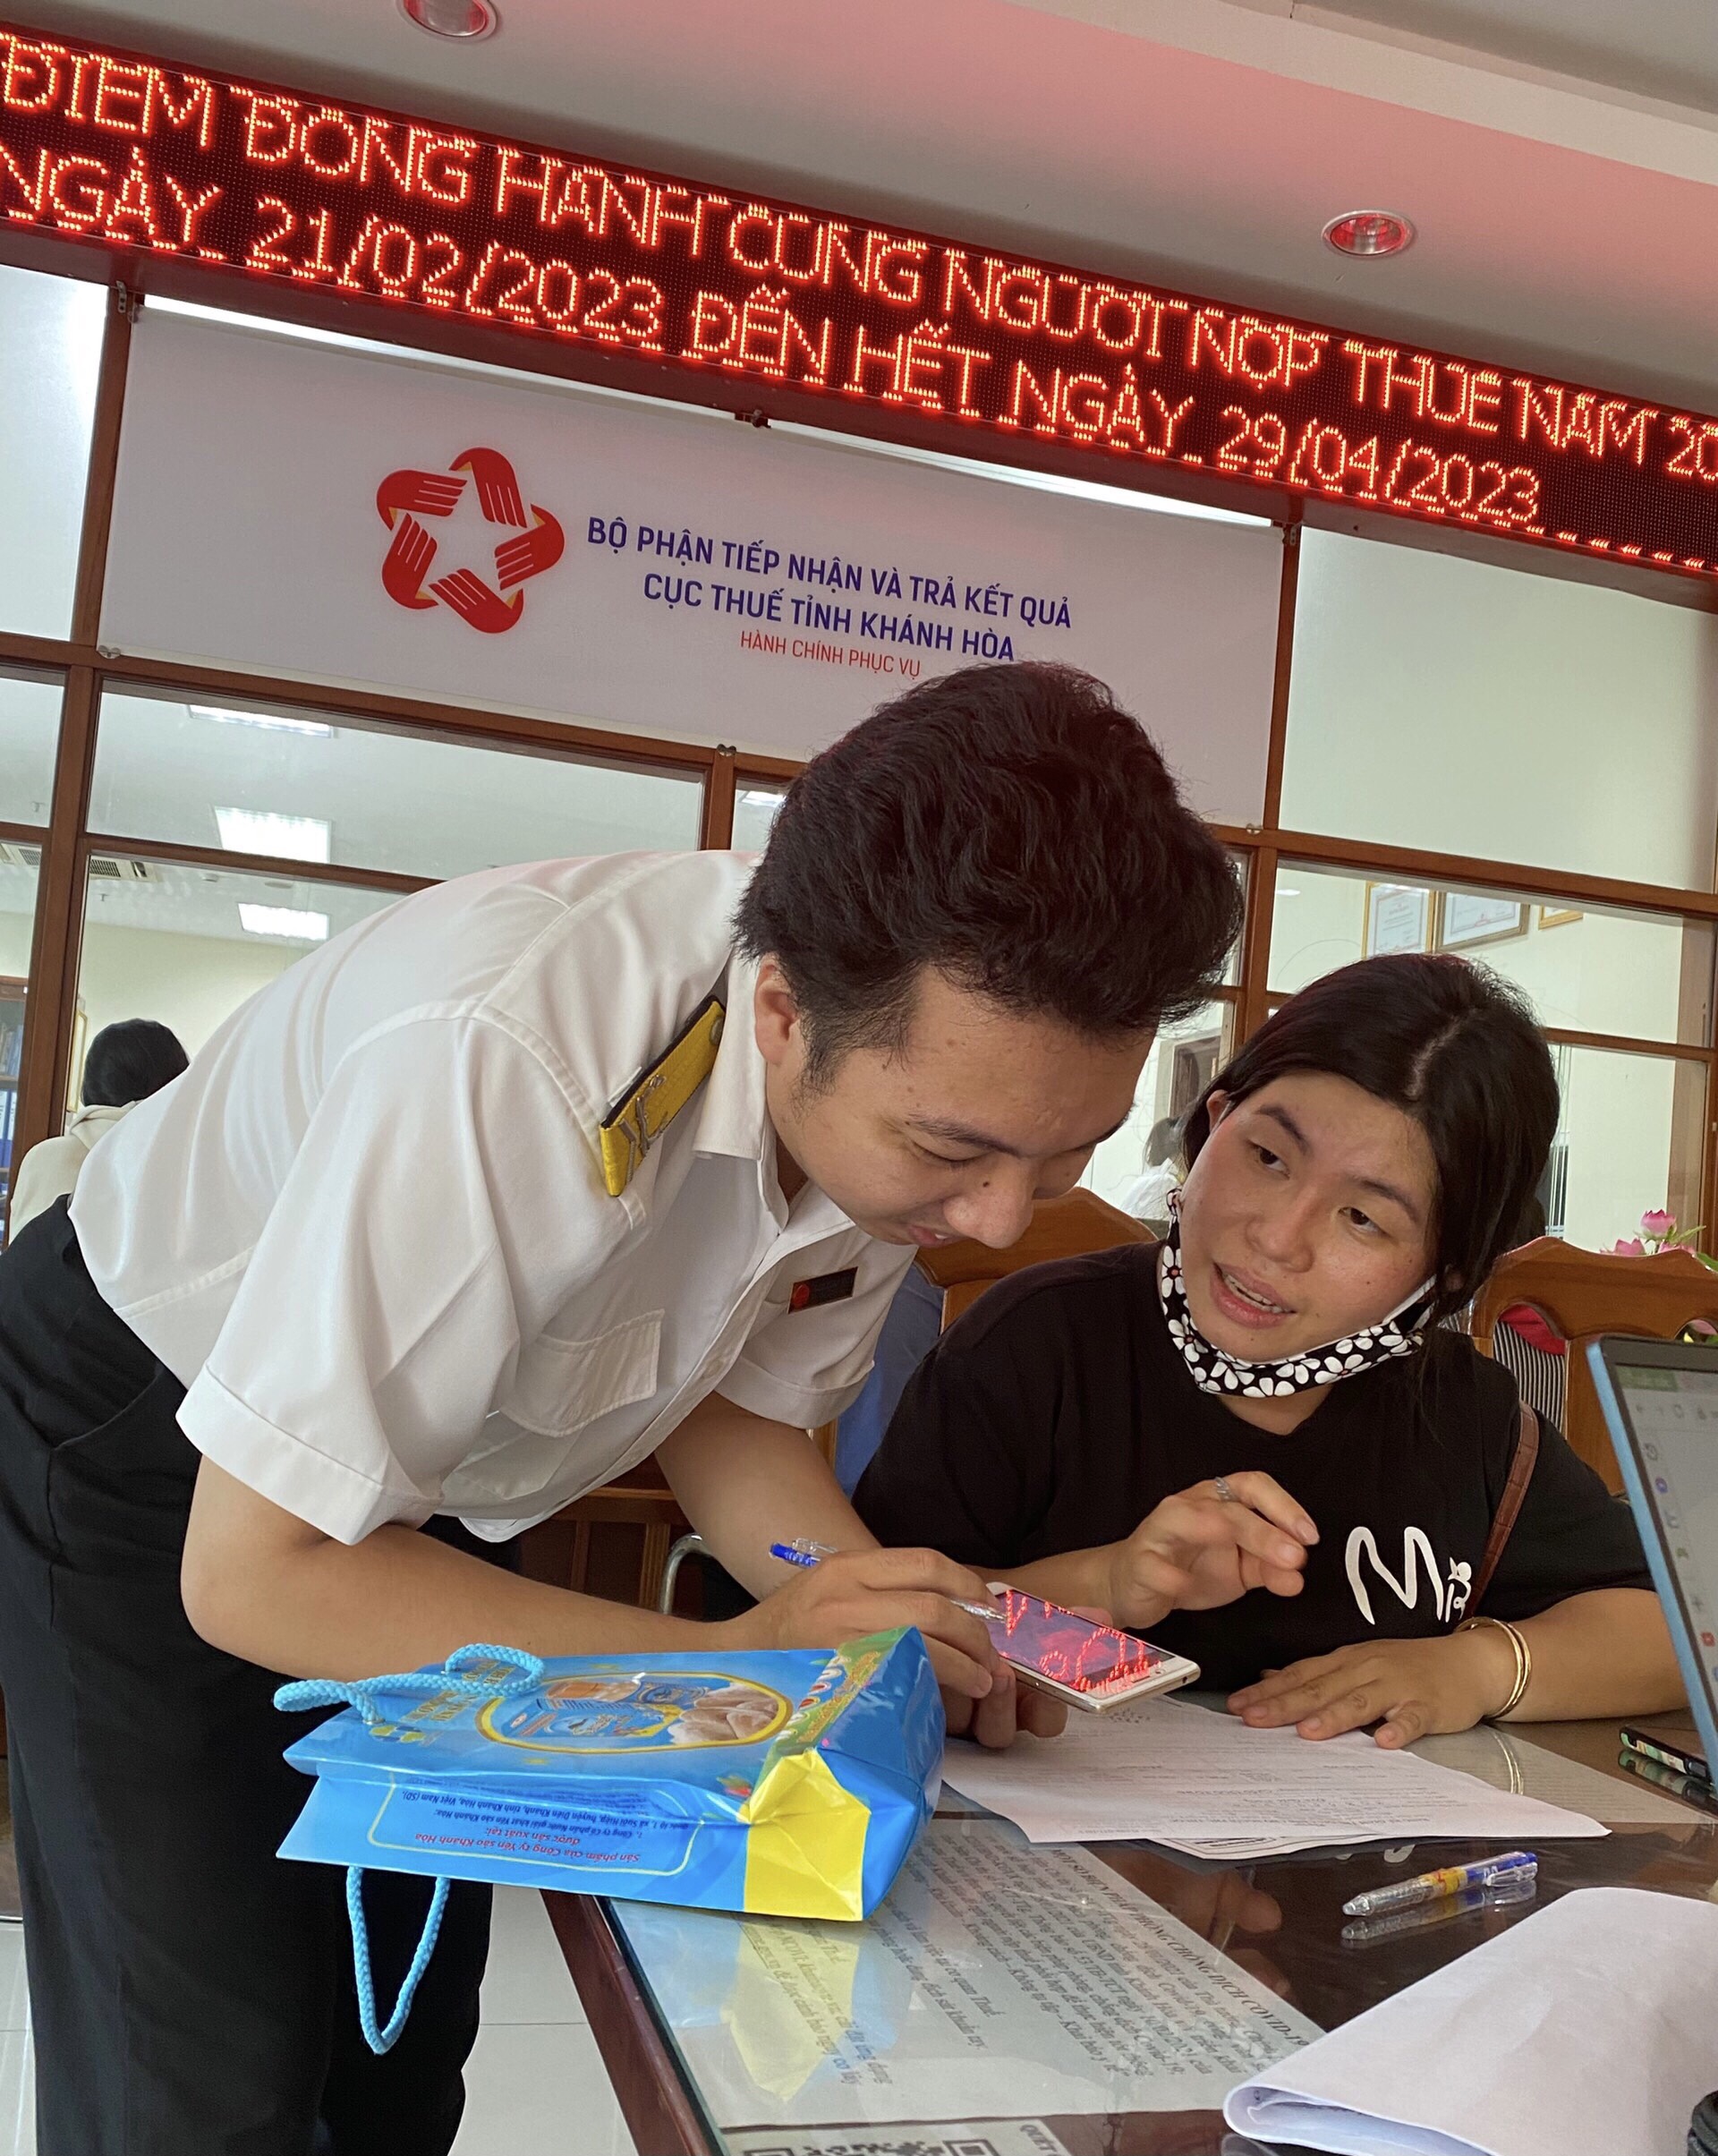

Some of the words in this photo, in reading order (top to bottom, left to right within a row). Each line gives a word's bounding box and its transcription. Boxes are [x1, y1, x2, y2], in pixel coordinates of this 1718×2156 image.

[250, 195, 661, 338] 21/02/2023
[693, 283, 828, 375] ĐẾN
[855, 320, 990, 405] HẾT
[1013, 360, 1194, 448] NGÀY
[1218, 404, 1539, 523] 29/04/2023
[588, 516, 626, 554] BỘ
[637, 526, 713, 566] PHẬN
[722, 540, 779, 575] TIẾP
[787, 554, 863, 593] NHẬN
[871, 567, 902, 599] VÀ
[909, 575, 957, 609] TRẢ
[965, 583, 1014, 618] KẾT
[1020, 596, 1071, 628] QUẢ
[643, 573, 702, 609] CỤC
[710, 584, 785, 622] THUẾ
[791, 594, 851, 634] TỈNH
[860, 611, 953, 652] KHÁNH
[961, 627, 1015, 661] HÒA
[740, 629, 787, 654] HÀNH
[792, 639, 843, 665] CHÍNH
[849, 649, 894, 674] PHỤC
[898, 657, 921, 680] VỤ
[415, 1833, 437, 1844] Hòa
[439, 1836, 473, 1846] Khánh
[520, 1842, 530, 1851] ty
[532, 1845, 560, 1856] Công
